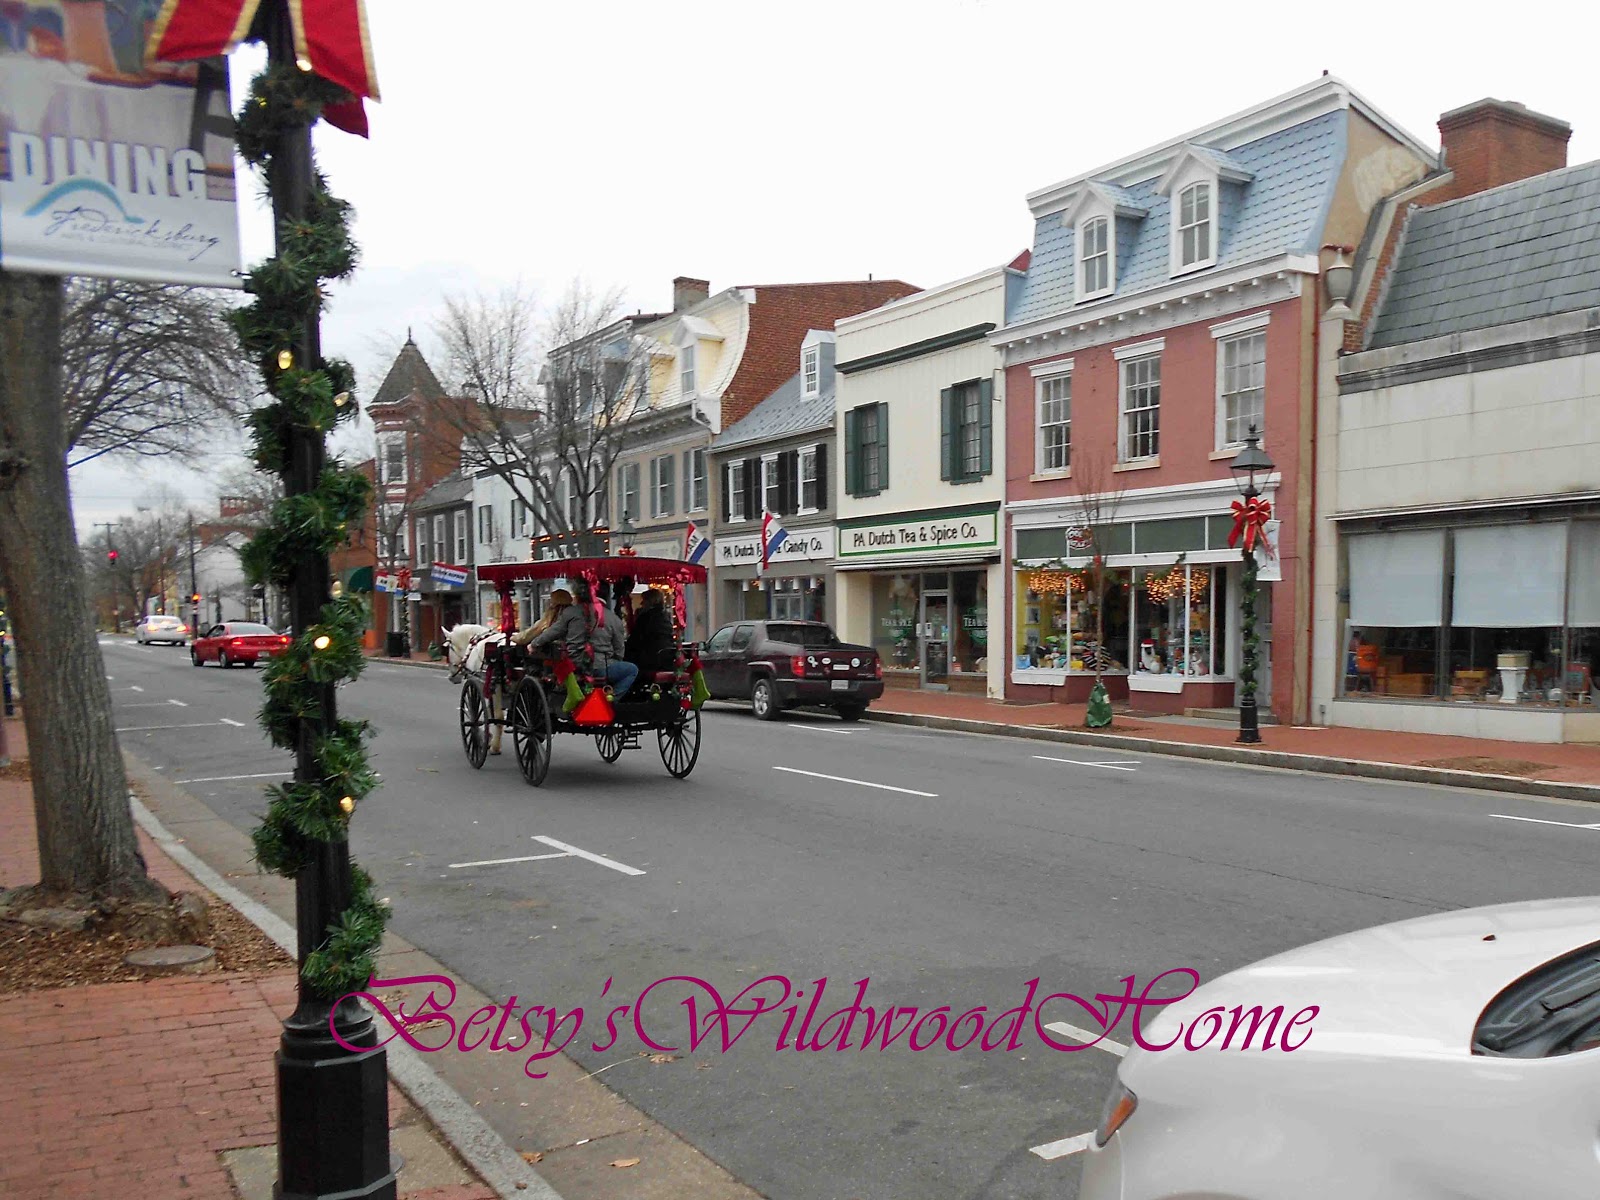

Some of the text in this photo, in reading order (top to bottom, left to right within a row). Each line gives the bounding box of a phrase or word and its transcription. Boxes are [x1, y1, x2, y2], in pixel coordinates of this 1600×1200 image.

[11, 131, 207, 199] DINING
[853, 532, 866, 547] PA
[868, 529, 896, 546] Dutch
[898, 528, 916, 544] Tea
[919, 526, 928, 542] &
[930, 524, 958, 545] Spice
[734, 543, 755, 558] Dutch
[783, 538, 809, 554] Candy
